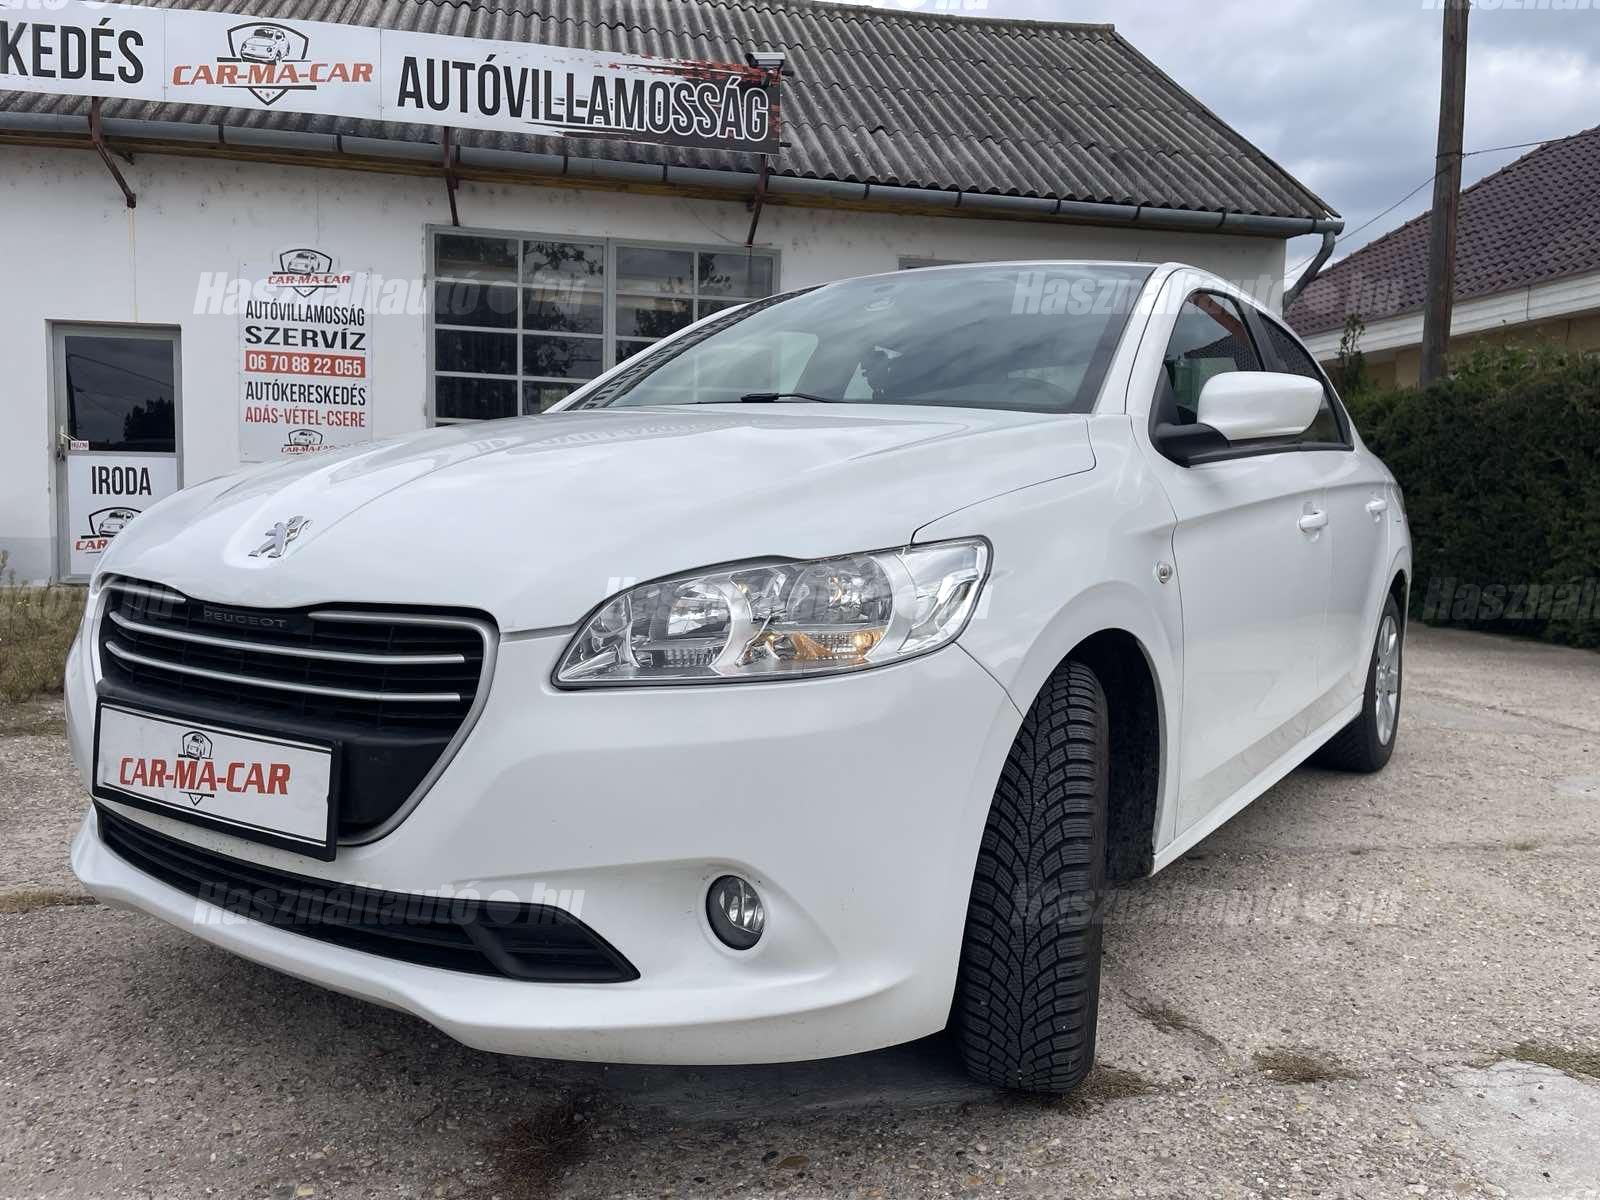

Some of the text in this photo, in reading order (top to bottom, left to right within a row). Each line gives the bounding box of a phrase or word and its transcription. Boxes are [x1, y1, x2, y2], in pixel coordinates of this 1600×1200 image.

[0, 17, 144, 84] KEDÉS
[172, 62, 373, 86] CAR-MA-CAR
[397, 53, 769, 141] AUTÓVILLAMOSSÁG
[267, 274, 352, 285] CAR-MA-CAR
[245, 298, 365, 327] AUTÓVILLAMOSSÁG
[245, 325, 366, 351] SZERVÍZ
[249, 354, 361, 376] 06 70 88 22 055
[245, 379, 366, 406] AUTÓKERESKEDÉS
[245, 404, 366, 428] ADÁS-VÉTEL-CSERE
[91, 466, 152, 496] IRODA
[204, 609, 287, 628] PEUGEOT
[119, 757, 291, 795] CAR-MA-CAR
